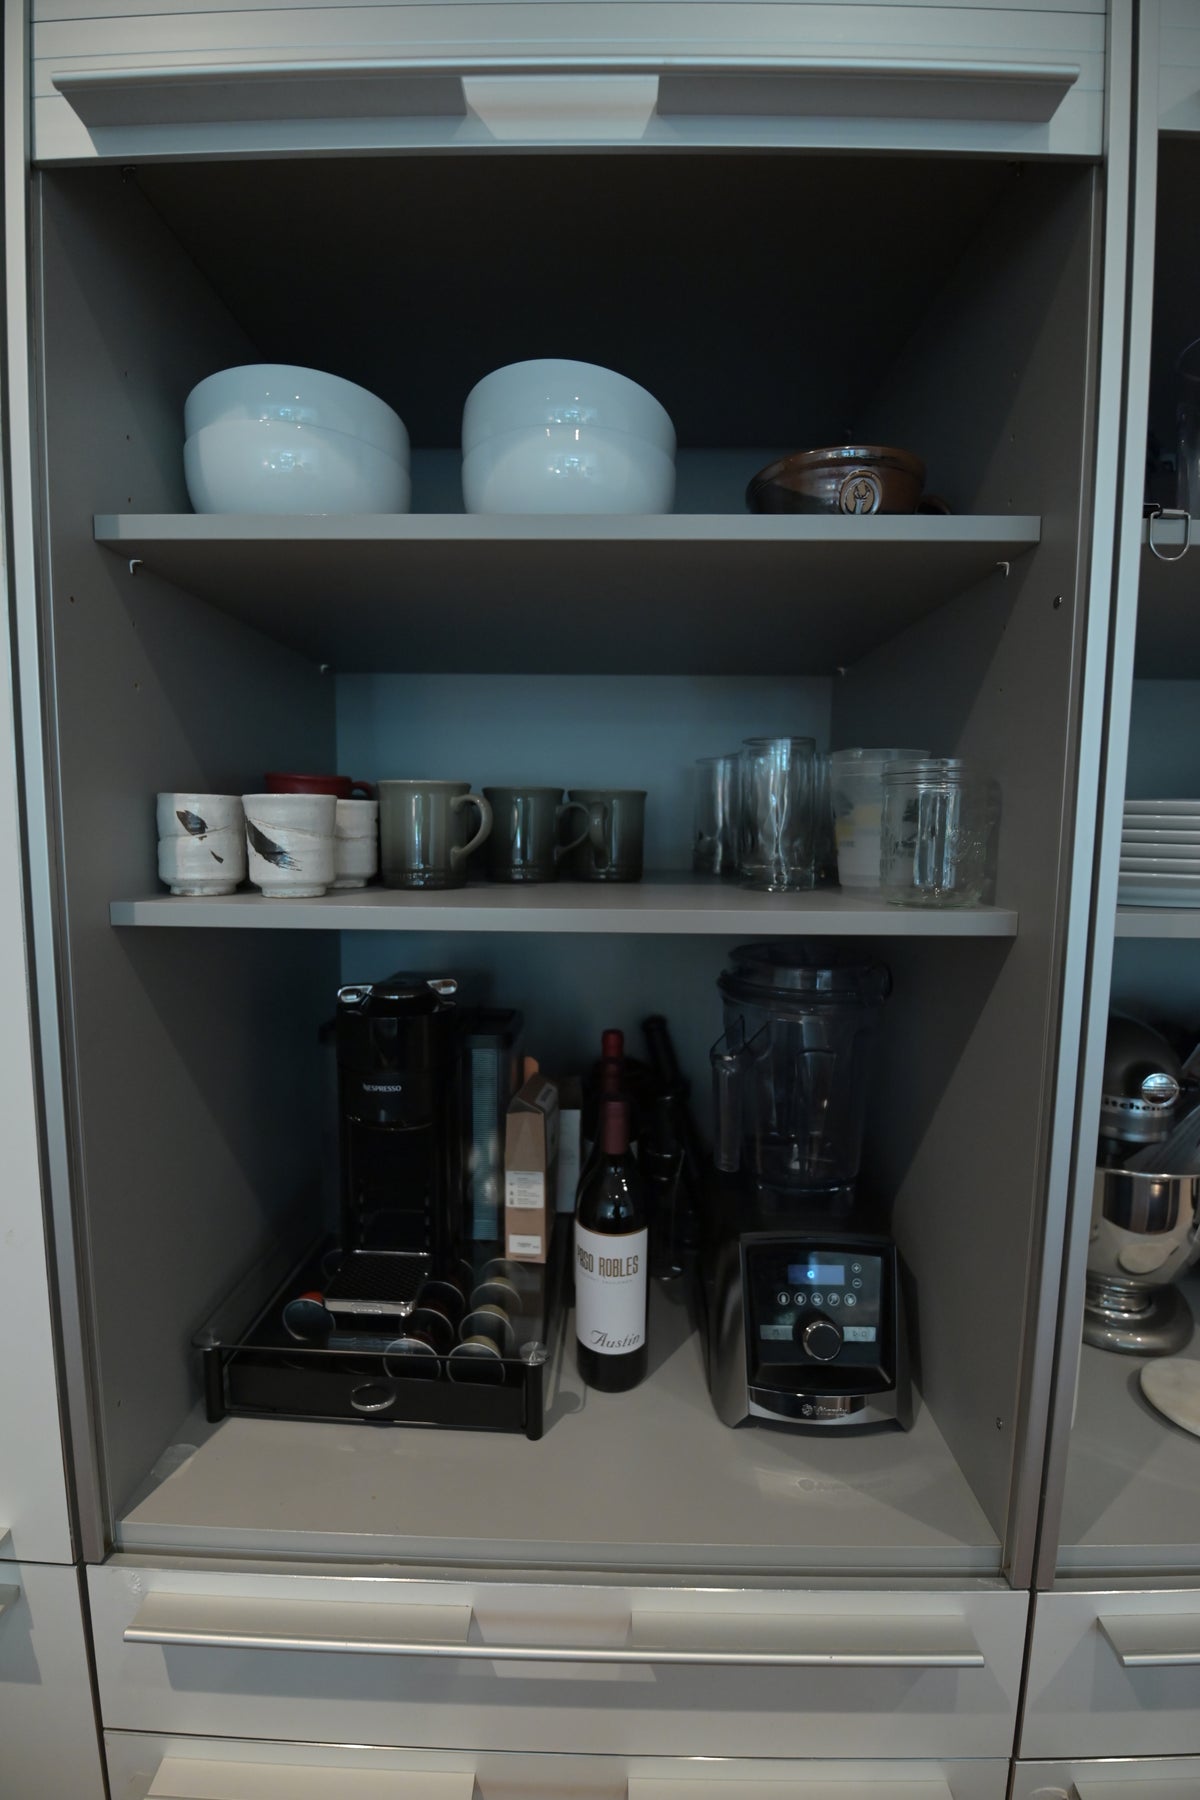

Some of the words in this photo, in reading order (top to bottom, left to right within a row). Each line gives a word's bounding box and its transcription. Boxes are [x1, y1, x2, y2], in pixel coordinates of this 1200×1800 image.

[362, 1082, 402, 1092] NESPRESSO
[598, 1254, 639, 1279] ROBLES
[590, 1329, 640, 1349] Austin
